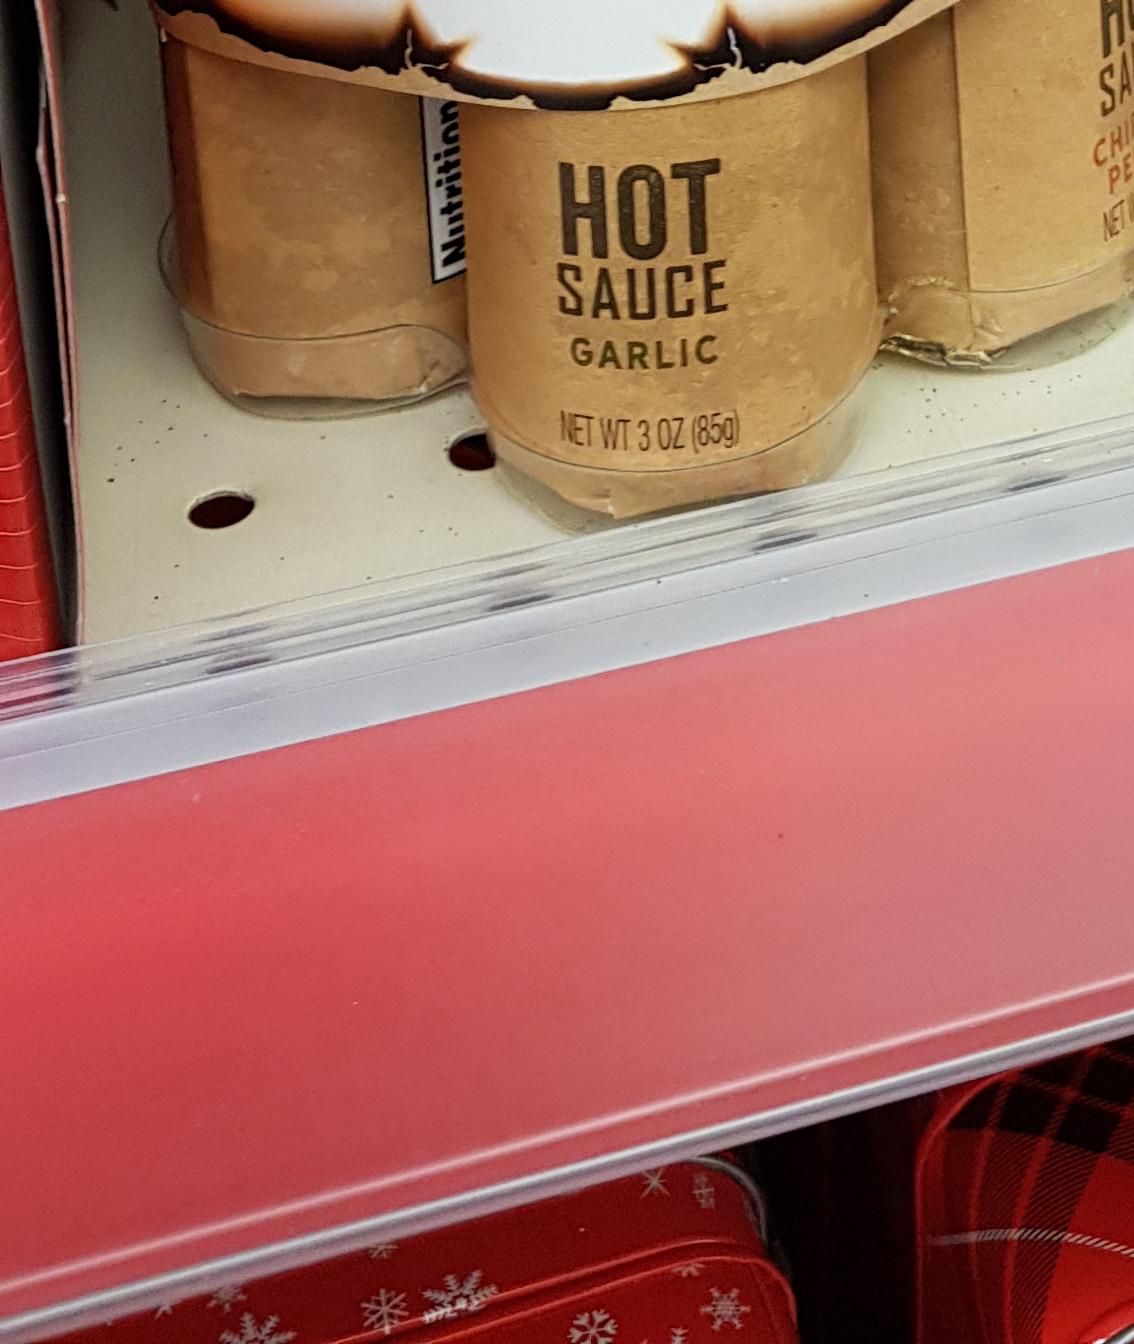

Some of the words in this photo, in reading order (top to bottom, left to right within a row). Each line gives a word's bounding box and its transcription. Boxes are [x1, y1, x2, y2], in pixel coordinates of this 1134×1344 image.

[557, 157, 722, 262] HOT
[556, 258, 730, 321] SAUCE
[570, 334, 720, 371] GARLIC
[559, 409, 595, 448] NET
[599, 417, 632, 451] WT
[637, 419, 651, 451] 3
[658, 416, 686, 450] OZ
[690, 408, 741, 454] (85g)
